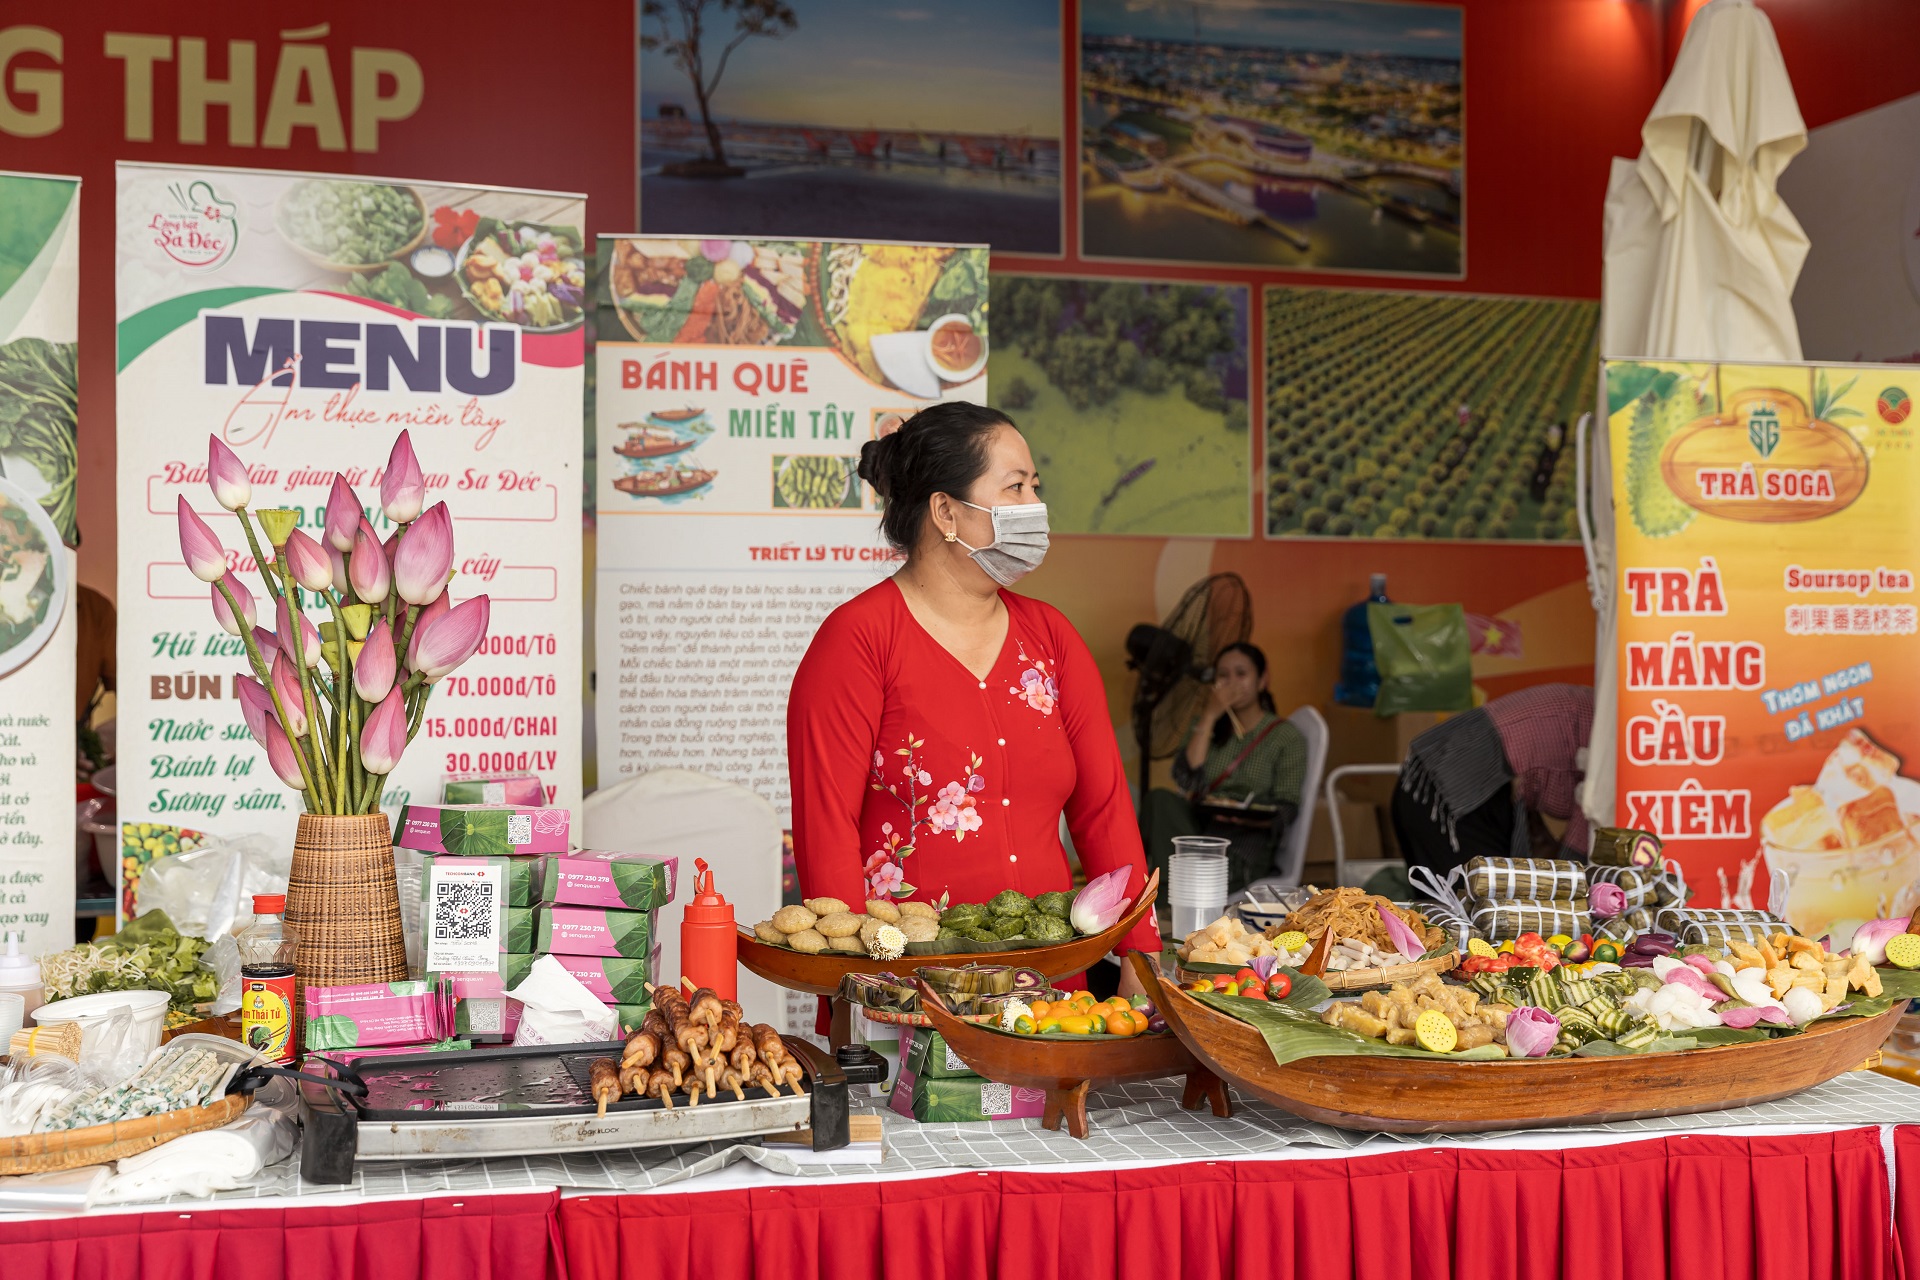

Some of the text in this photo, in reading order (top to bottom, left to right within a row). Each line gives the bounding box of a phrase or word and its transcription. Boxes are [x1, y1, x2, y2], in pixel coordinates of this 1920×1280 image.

[0, 22, 425, 153] G THÁP
[160, 229, 221, 250] Sa Đéc
[205, 316, 515, 396] MENU
[621, 351, 809, 397] BÁNH QUÊ
[323, 383, 380, 429] thực
[386, 397, 453, 426] miền
[729, 402, 855, 439] MIỀN TÂY
[164, 461, 209, 484] Bán
[284, 465, 334, 491] gian
[457, 468, 489, 491] Sa
[498, 469, 541, 492] Đéc
[1767, 473, 1830, 496] SOGA
[749, 541, 801, 560] TRIẾT
[461, 552, 501, 582] cây
[1788, 569, 1909, 592] Soursop tea
[654, 583, 683, 595] bánh
[1628, 559, 1723, 612] TRÀ
[730, 600, 747, 612] tay
[152, 631, 197, 659] Hủ
[675, 658, 703, 669] bánh
[1629, 635, 1763, 688] MÃNG
[151, 670, 221, 700] BÚN
[446, 674, 557, 698] 70.000đ/TÔ
[1822, 661, 1873, 695] NGON
[149, 716, 557, 744] Nước 15.000đ/CHAI
[1629, 702, 1722, 762] CẦU
[1785, 697, 1864, 742] ĐÃ KHÁT
[150, 750, 557, 781] Bánh lọt 30.000đ/LY
[149, 788, 227, 818] Sương
[1628, 779, 1749, 836] XIÊM
[9, 870, 44, 887] được
[23, 912, 49, 928] xay
[252, 1008, 269, 1020] Thái
